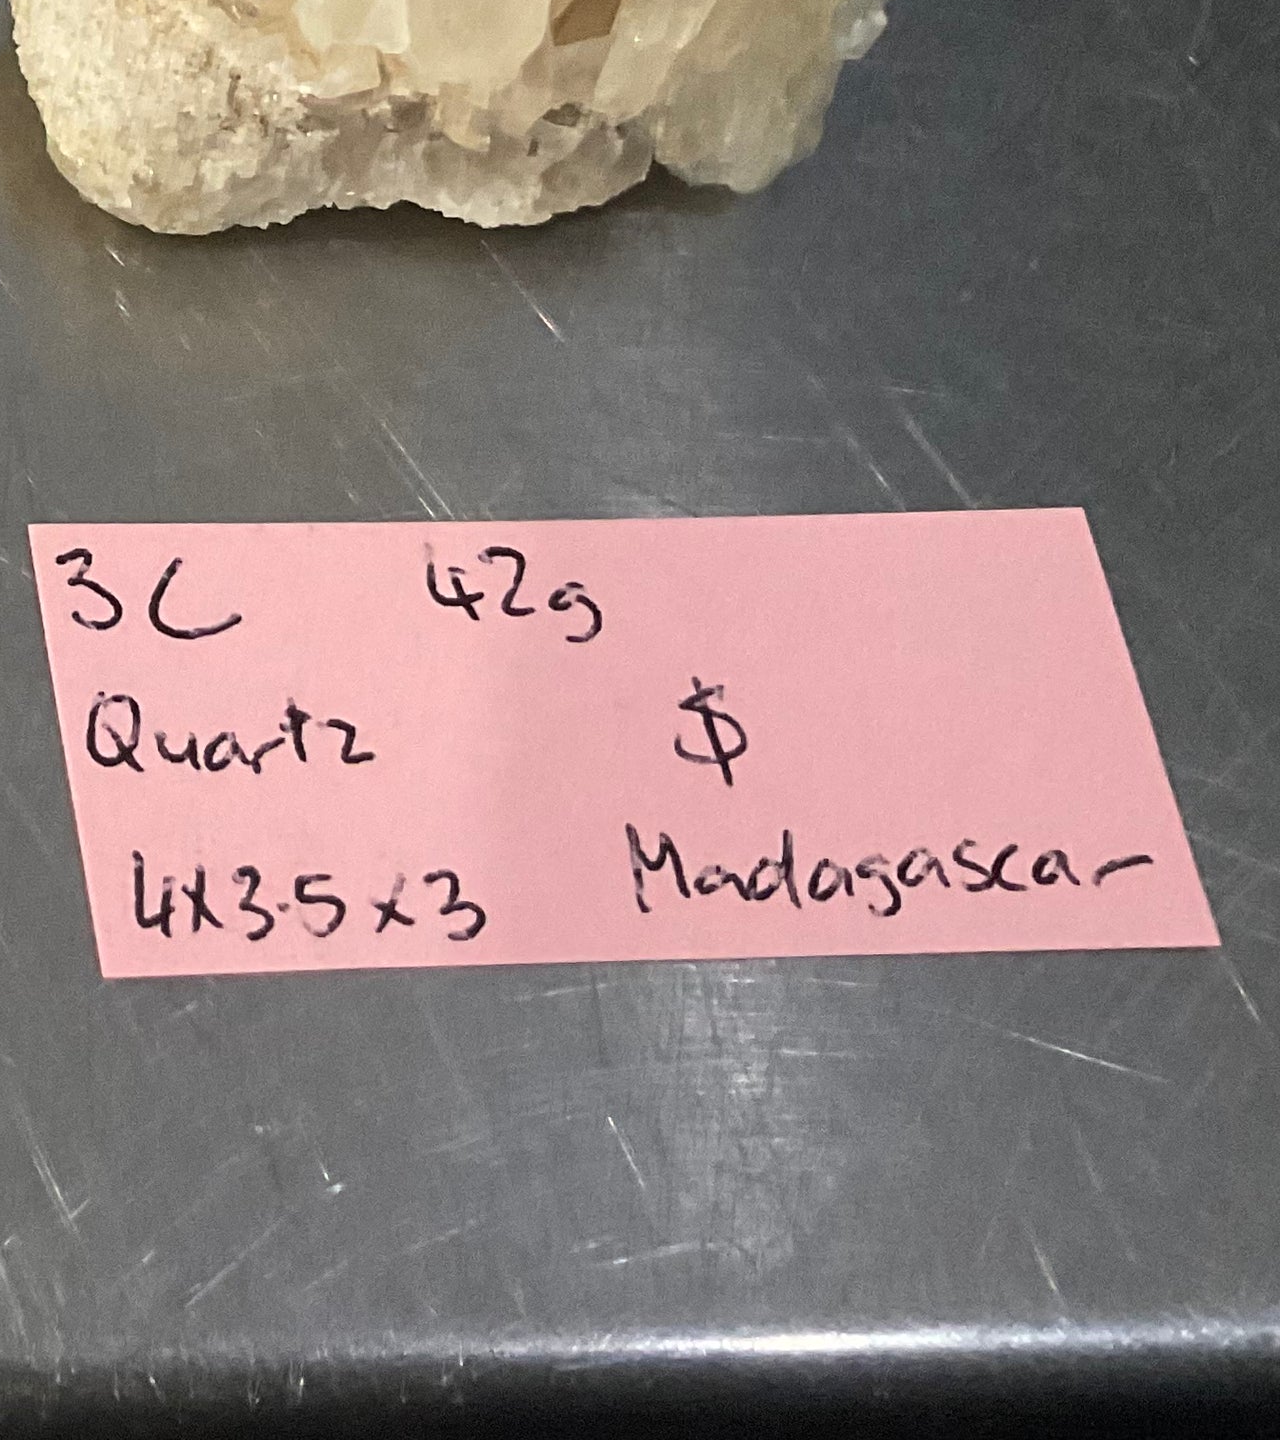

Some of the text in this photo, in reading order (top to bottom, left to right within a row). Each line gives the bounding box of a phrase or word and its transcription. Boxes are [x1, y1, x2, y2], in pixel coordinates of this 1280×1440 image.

[55, 545, 604, 645] 3C 42g
[84, 675, 750, 788] Quartz $
[623, 821, 1156, 919] Madagascar
